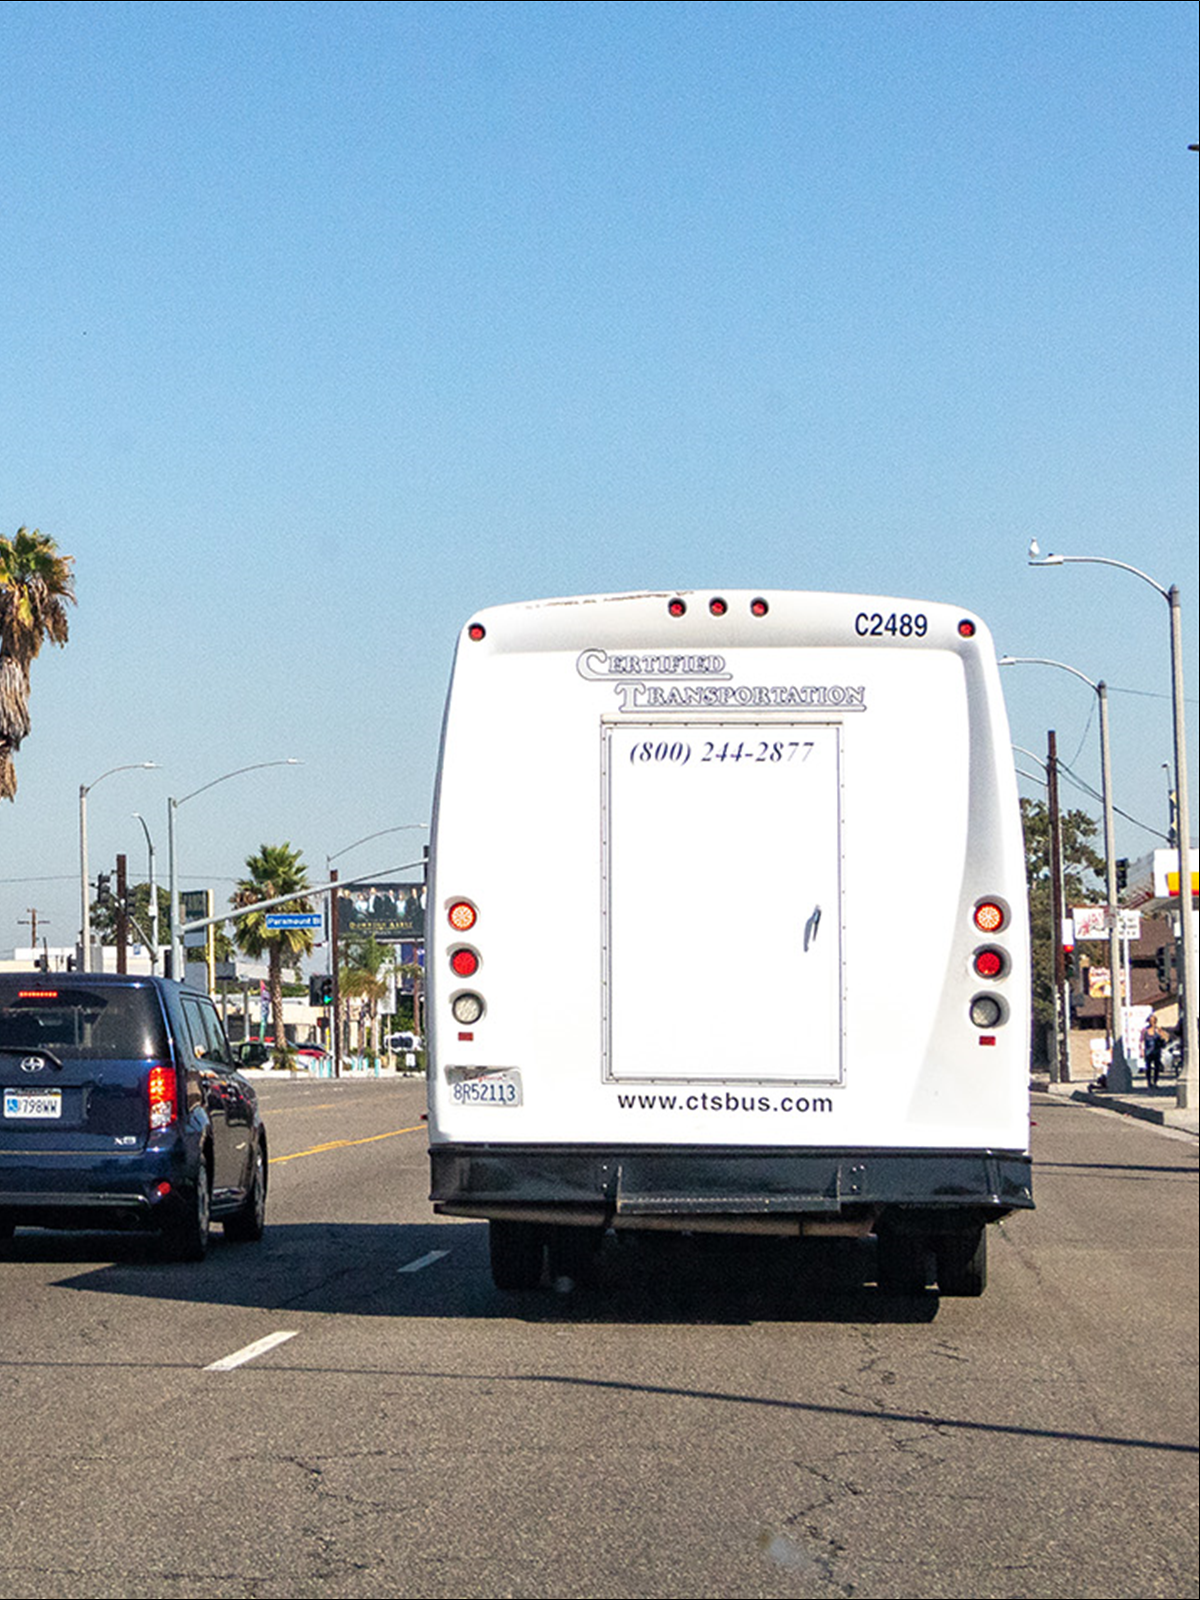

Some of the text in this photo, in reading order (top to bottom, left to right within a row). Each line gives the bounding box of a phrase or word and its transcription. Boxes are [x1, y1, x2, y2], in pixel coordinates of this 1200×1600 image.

[855, 613, 928, 637] C2489
[576, 648, 732, 680] CERTIFIED
[614, 682, 867, 713] TRANSPORTATION
[629, 741, 815, 766] (800) 244-2877
[453, 1082, 516, 1102] 8R52113
[618, 1092, 833, 1113] www.ctsbus.com
